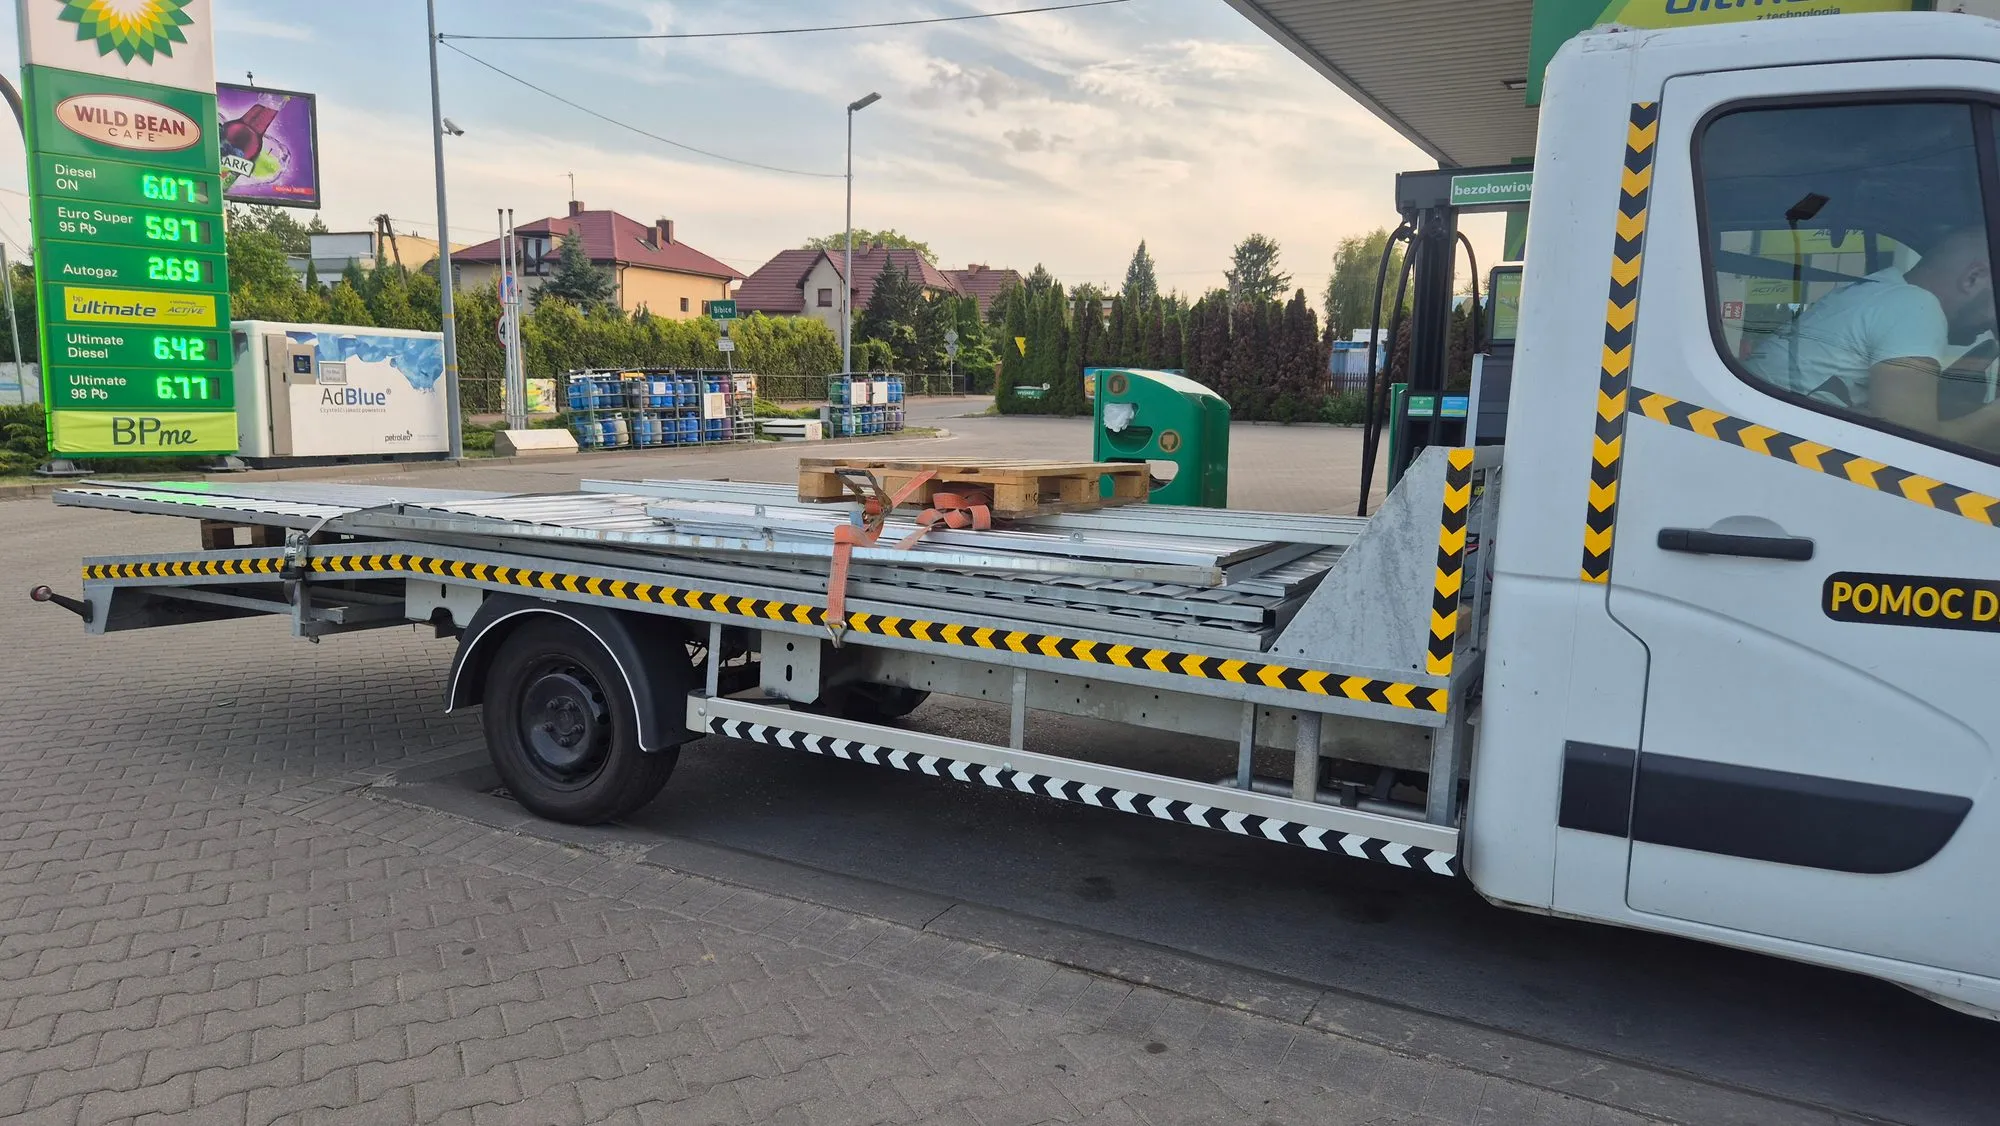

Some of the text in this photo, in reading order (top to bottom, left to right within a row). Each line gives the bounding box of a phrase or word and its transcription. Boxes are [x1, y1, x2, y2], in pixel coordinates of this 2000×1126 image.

[74, 104, 185, 136] WILD BEAN
[108, 127, 155, 142] CAFE
[55, 163, 96, 179] Diesel
[219, 155, 249, 173] ARK
[56, 178, 79, 191] ON
[142, 174, 195, 203] 6.07
[58, 207, 133, 224] Euro Super
[59, 221, 76, 232] 95
[145, 215, 198, 243] 5.97
[63, 263, 118, 279] Autogaz
[148, 256, 200, 283] 2.69
[73, 300, 157, 317] ultimate
[167, 306, 205, 315] ACTIVE
[67, 333, 124, 346] Ultimate
[67, 347, 109, 359] Diesel
[153, 336, 206, 361] 6.42
[69, 374, 127, 386] Ultimate
[156, 375, 208, 400] 6.77
[71, 388, 87, 399] 98
[1831, 581, 1965, 620] POMOC
